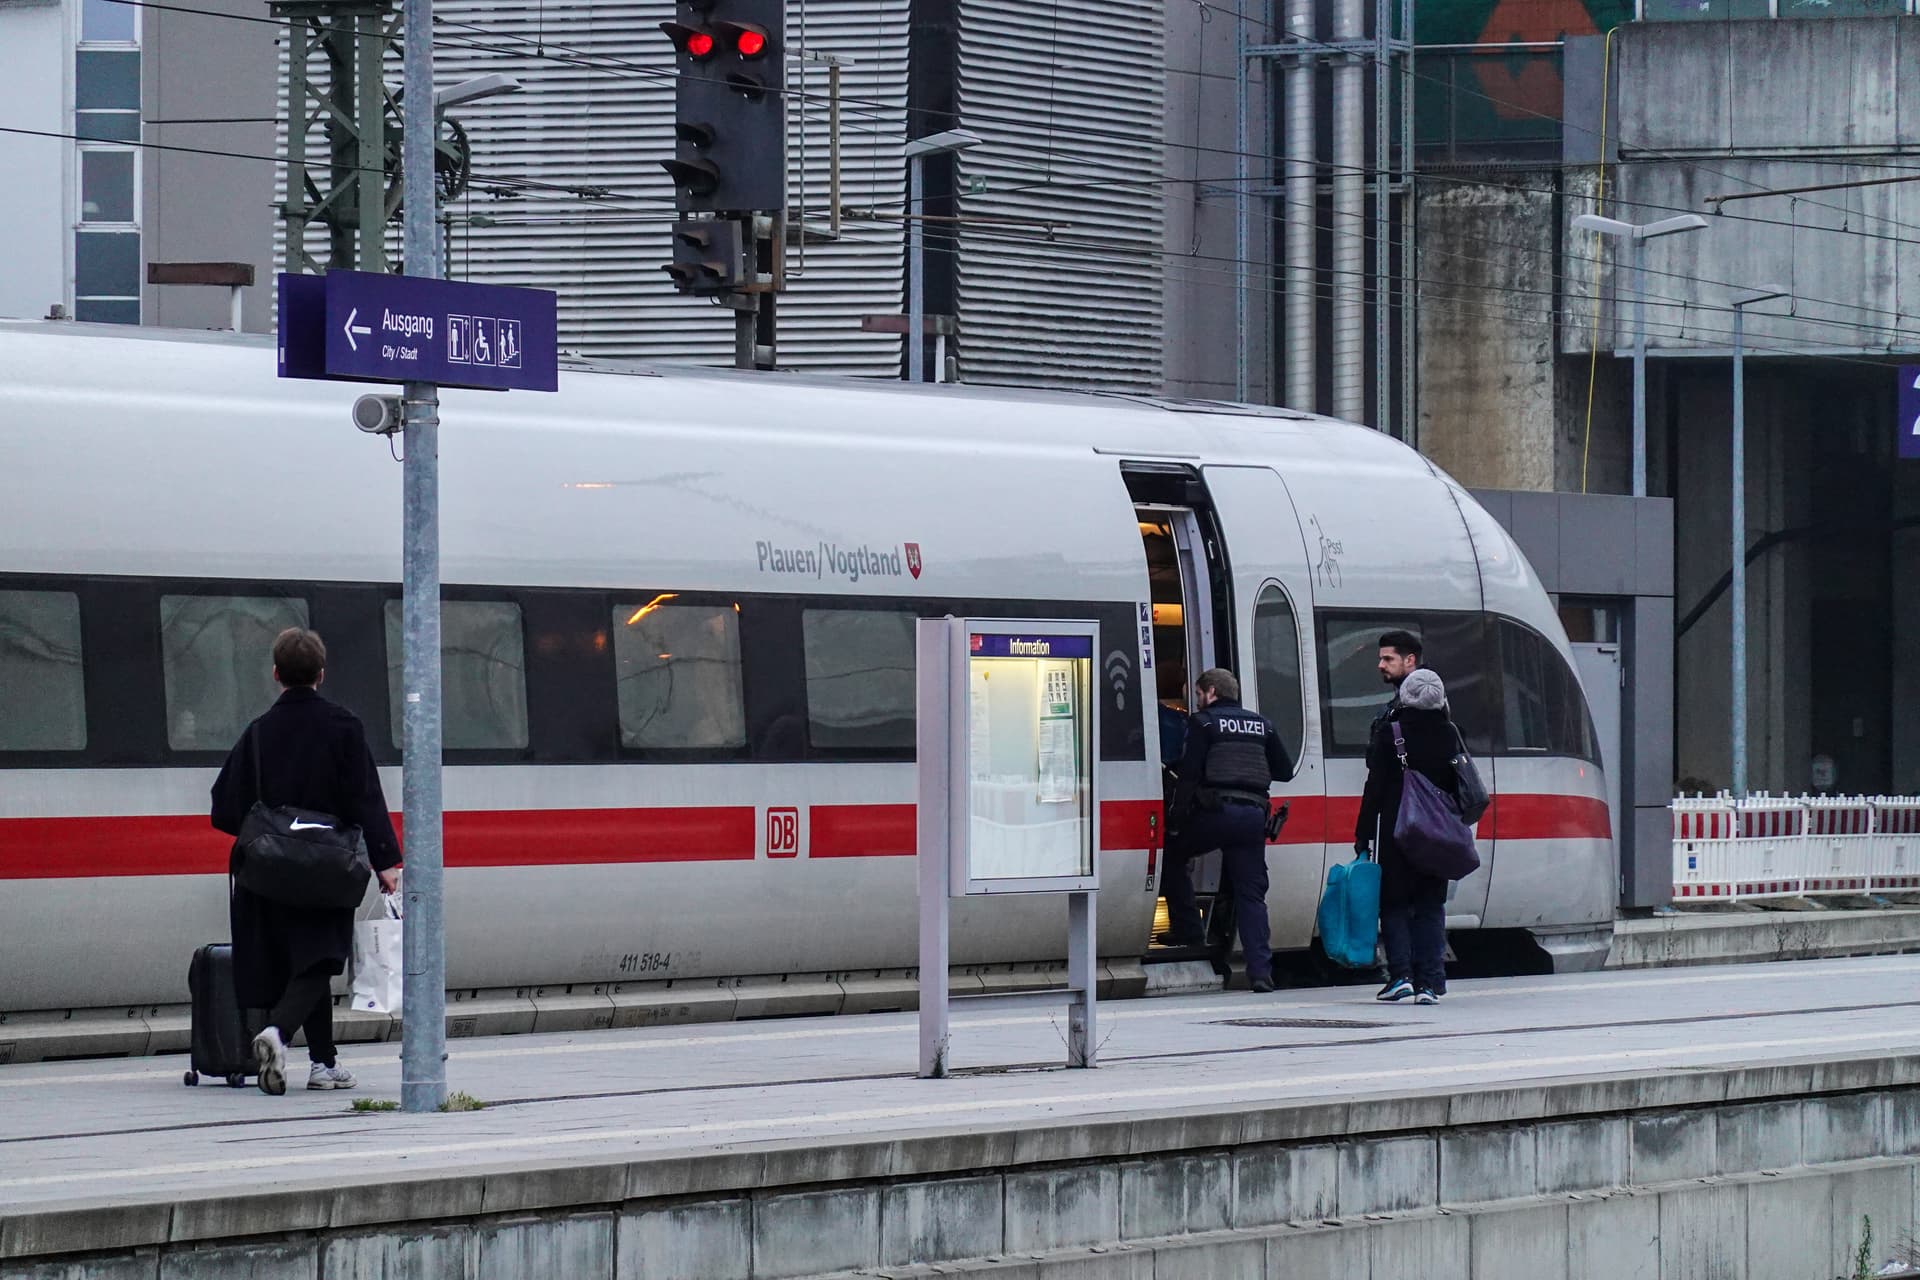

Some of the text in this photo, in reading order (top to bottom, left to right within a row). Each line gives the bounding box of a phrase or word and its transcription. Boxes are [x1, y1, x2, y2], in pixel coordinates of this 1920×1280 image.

[382, 308, 433, 339] Ausgang
[382, 344, 395, 360] City
[400, 347, 418, 360] Stadt
[1326, 538, 1344, 555] Psst
[756, 540, 901, 582] Plauen/Vogtland
[1009, 638, 1050, 655] Information
[1219, 718, 1265, 735] POLIZEI
[770, 815, 795, 850] DB
[620, 952, 671, 972] 411 518-4
